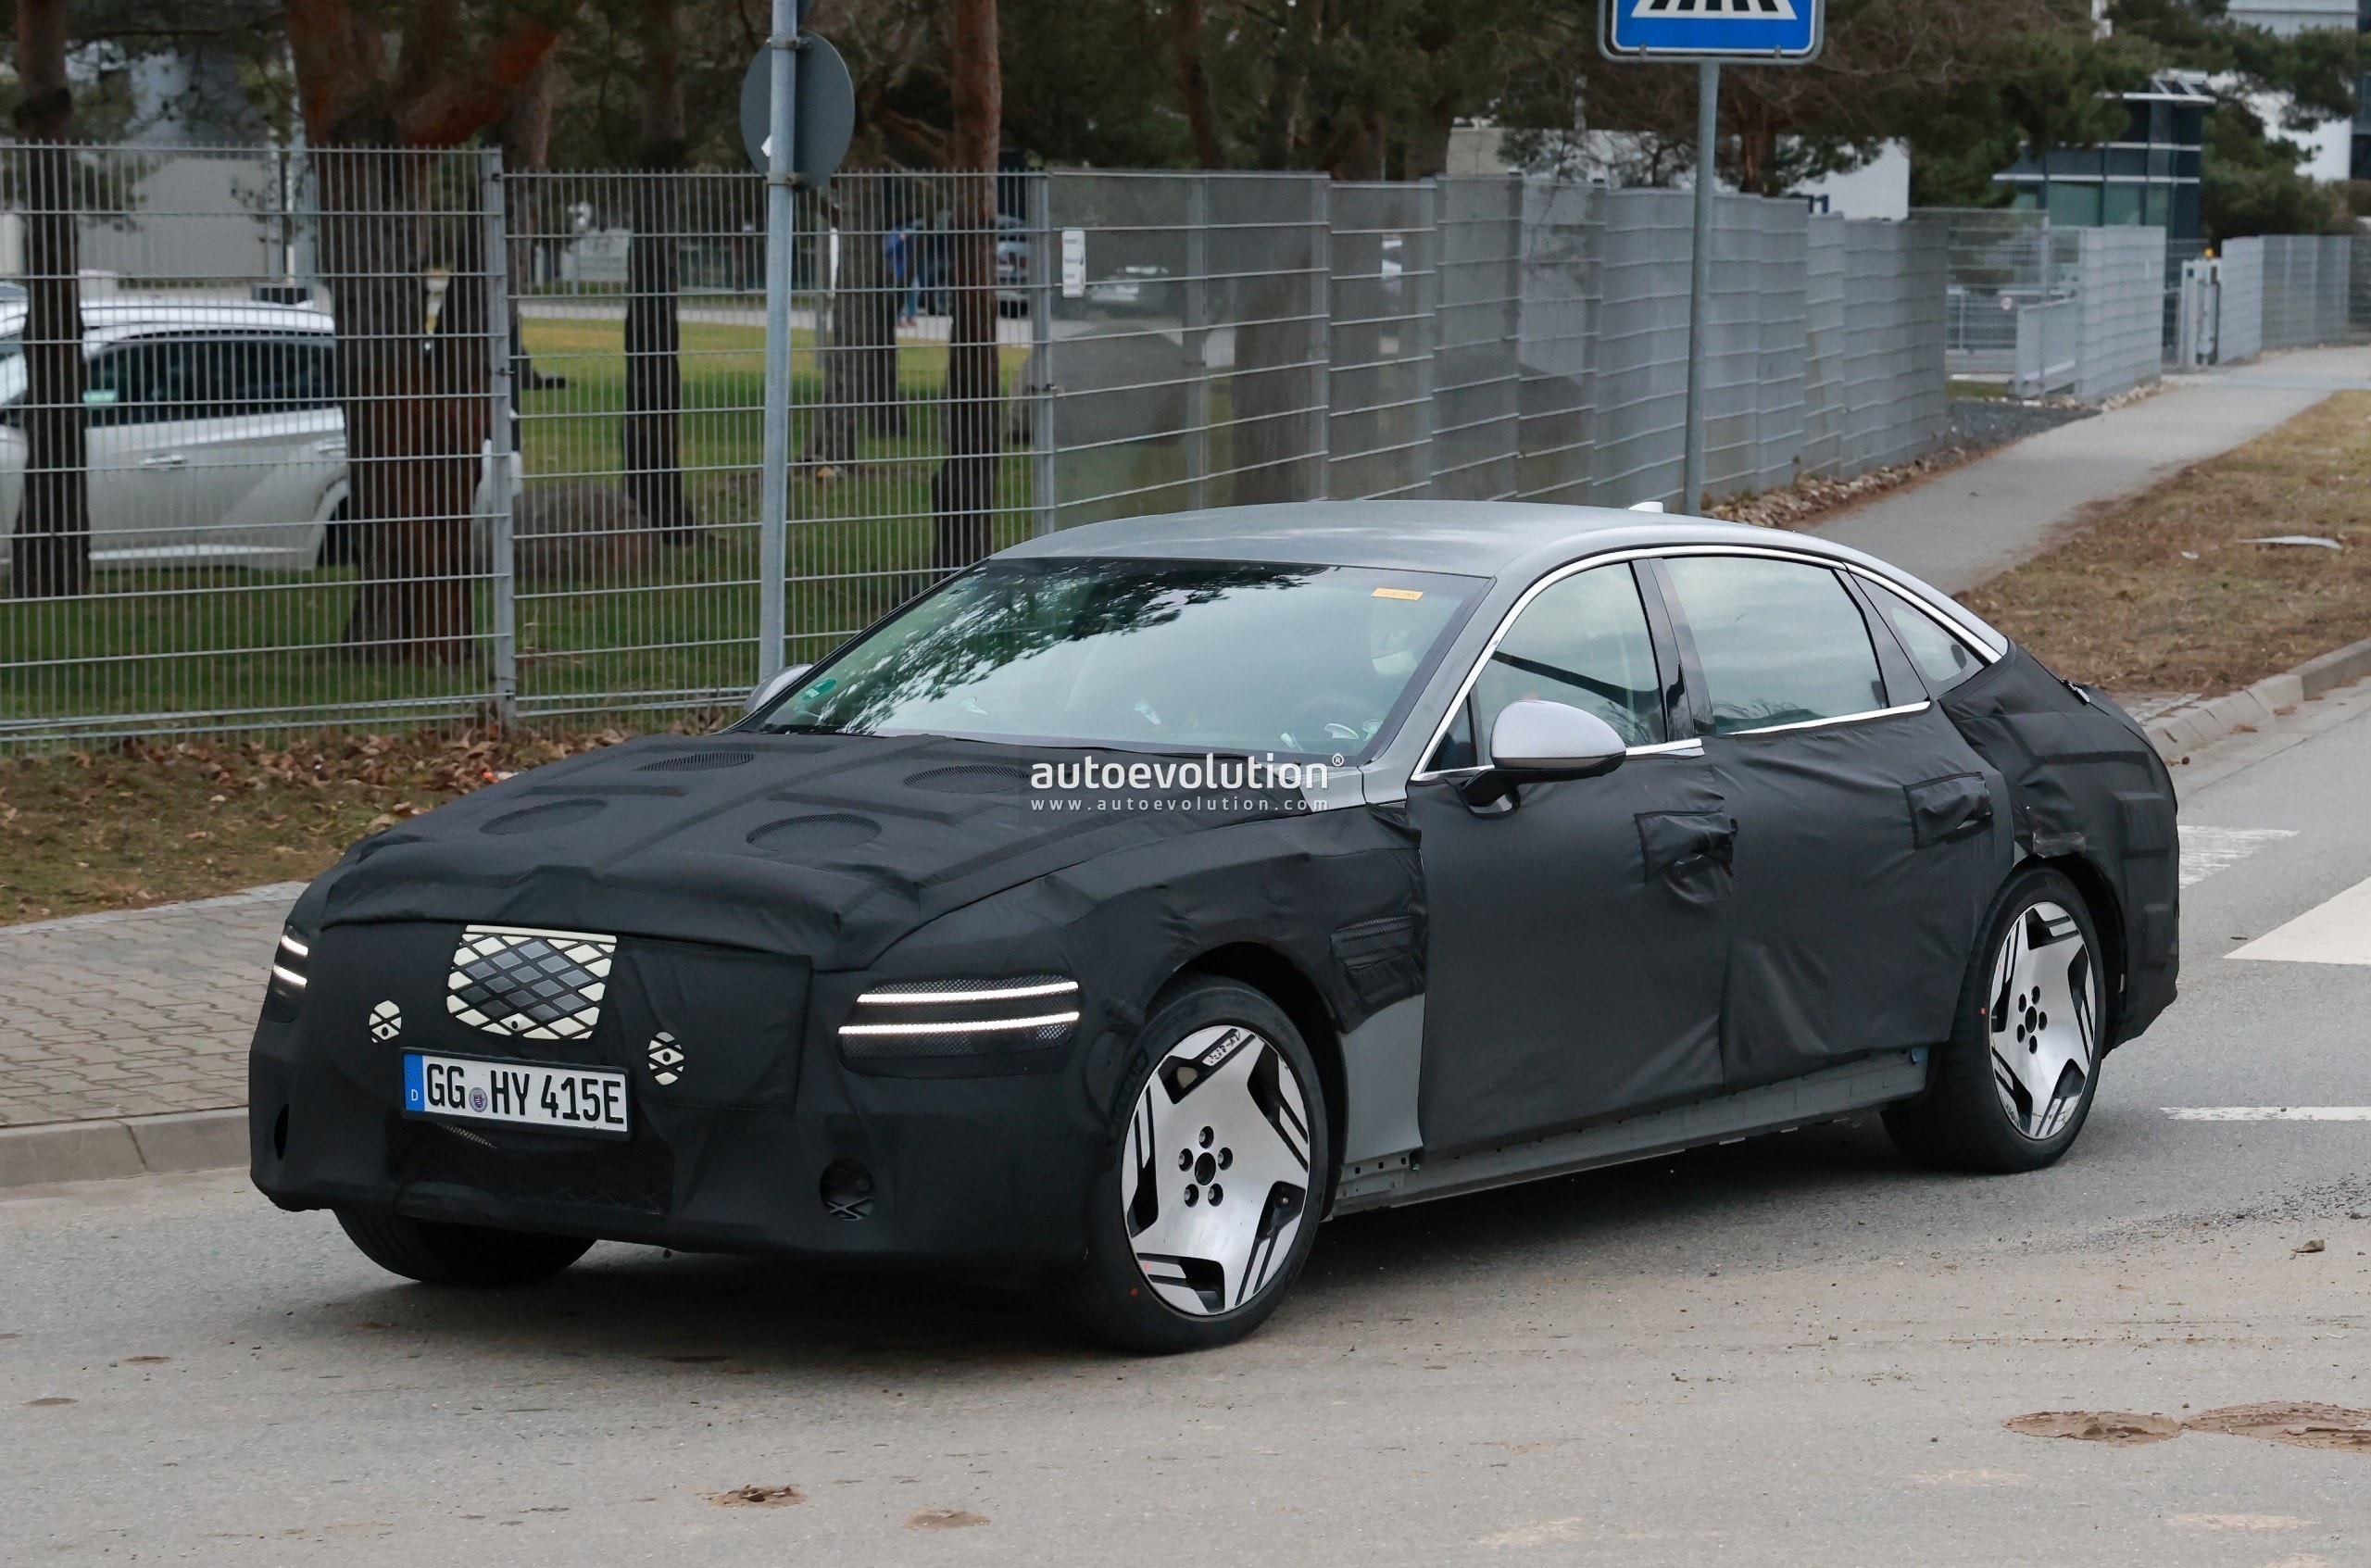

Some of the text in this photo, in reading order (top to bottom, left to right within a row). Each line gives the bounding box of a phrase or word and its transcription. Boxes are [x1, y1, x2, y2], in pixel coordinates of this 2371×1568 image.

[410, 1088, 419, 1101] D
[426, 1063, 624, 1123] GG HY 415E
